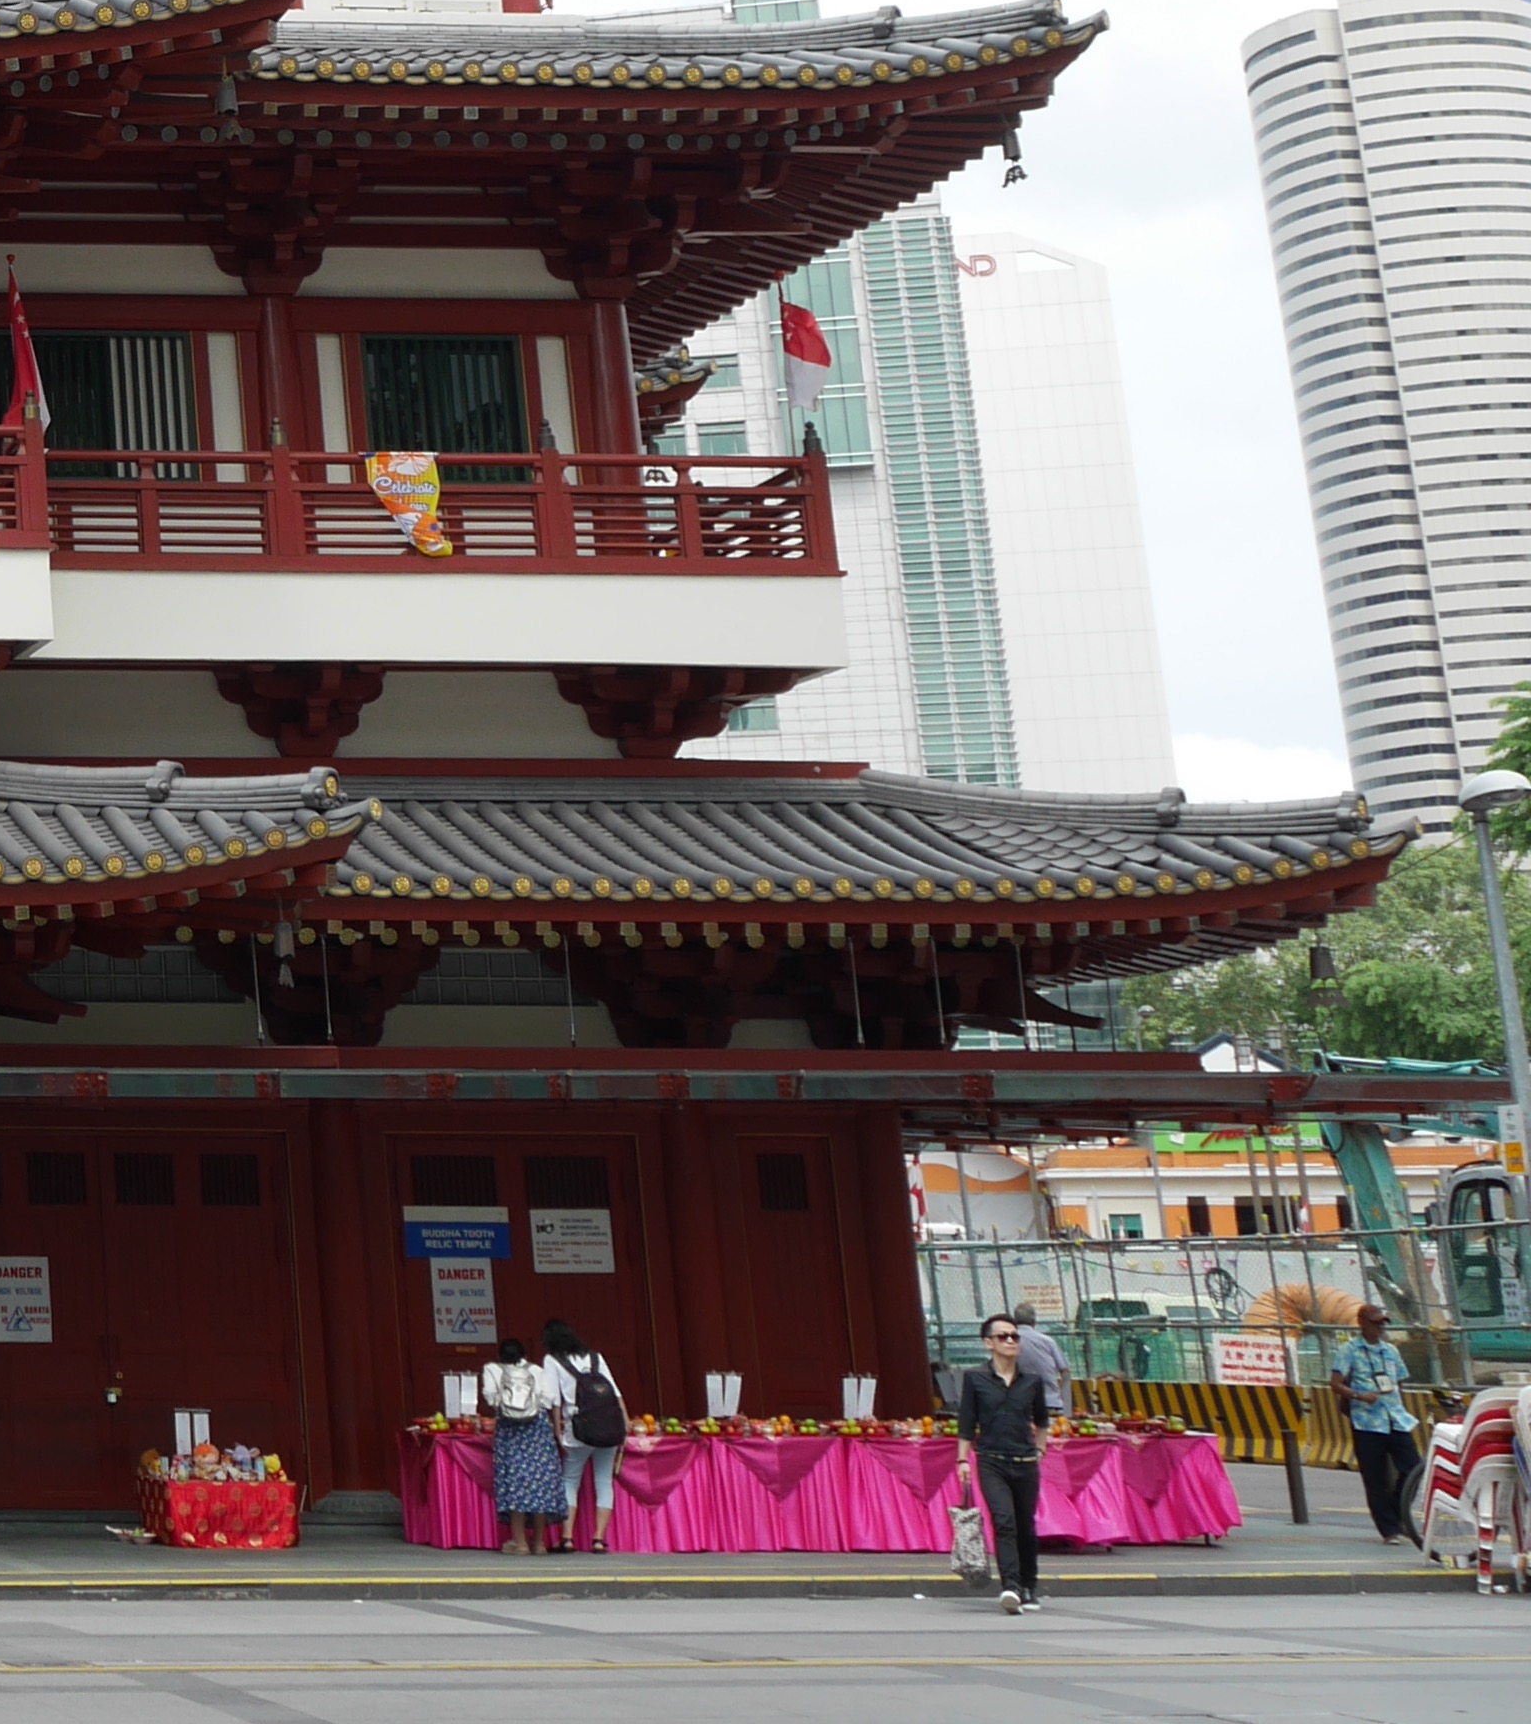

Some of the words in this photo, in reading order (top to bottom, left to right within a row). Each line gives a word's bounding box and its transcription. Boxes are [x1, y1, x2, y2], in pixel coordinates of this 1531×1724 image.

[372, 475, 437, 494] Celebrate
[421, 1228, 460, 1239] BUDDHA
[462, 1229, 496, 1239] TOOTH
[425, 1239, 453, 1249] RELIC
[455, 1239, 492, 1250] TEMPLE
[438, 1268, 486, 1280] DANGER
